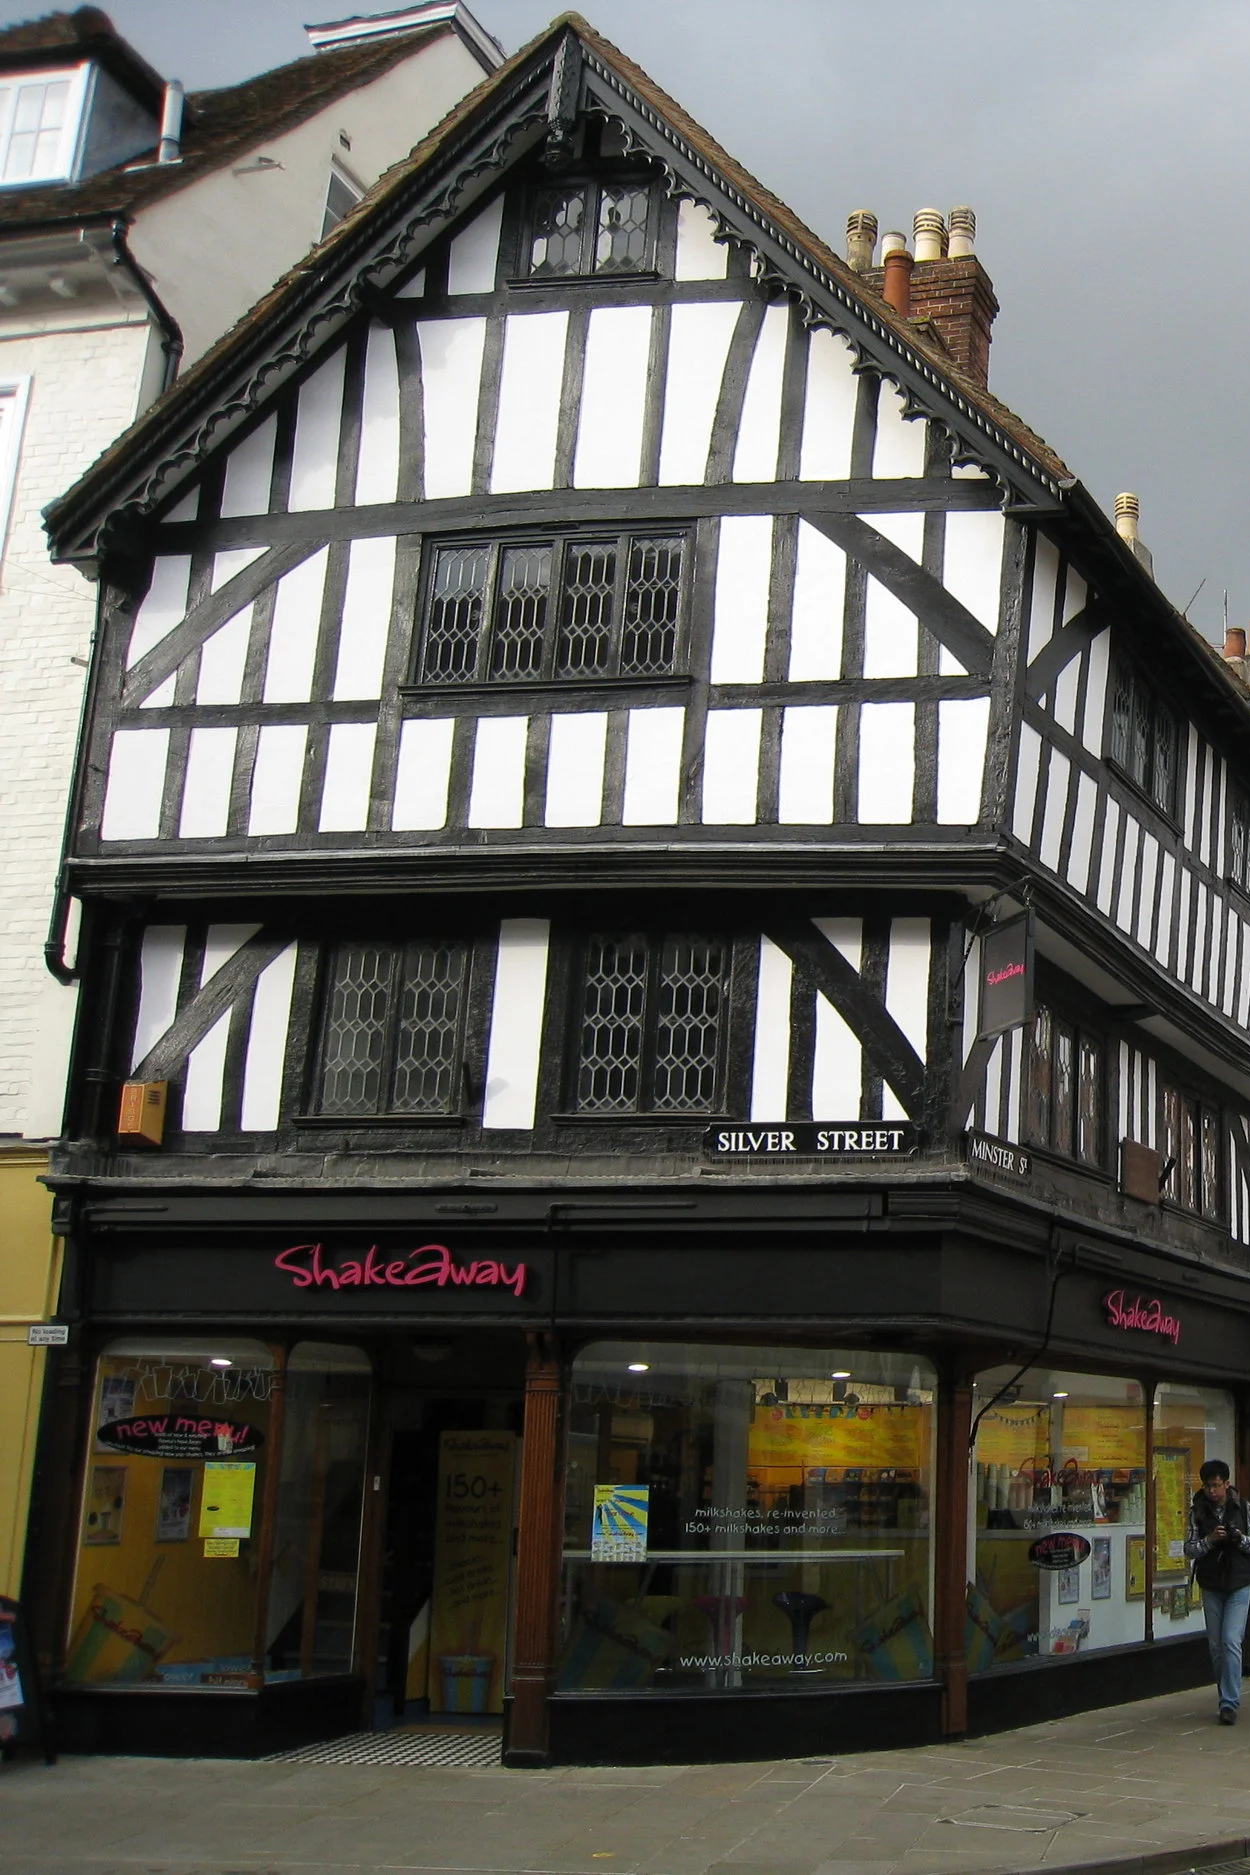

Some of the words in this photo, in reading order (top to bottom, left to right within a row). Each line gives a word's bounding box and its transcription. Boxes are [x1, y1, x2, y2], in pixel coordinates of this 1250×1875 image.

[718, 1131, 796, 1151] SILVER
[817, 1131, 904, 1151] STREET
[971, 1138, 1014, 1171] MINSTER
[116, 1417, 169, 1440] new
[446, 1474, 503, 1498] 150+
[685, 1524, 711, 1534] 150+
[715, 1523, 780, 1534] milkshakes
[783, 1522, 806, 1534] and
[679, 1650, 848, 1669] www.shakeaway.com
